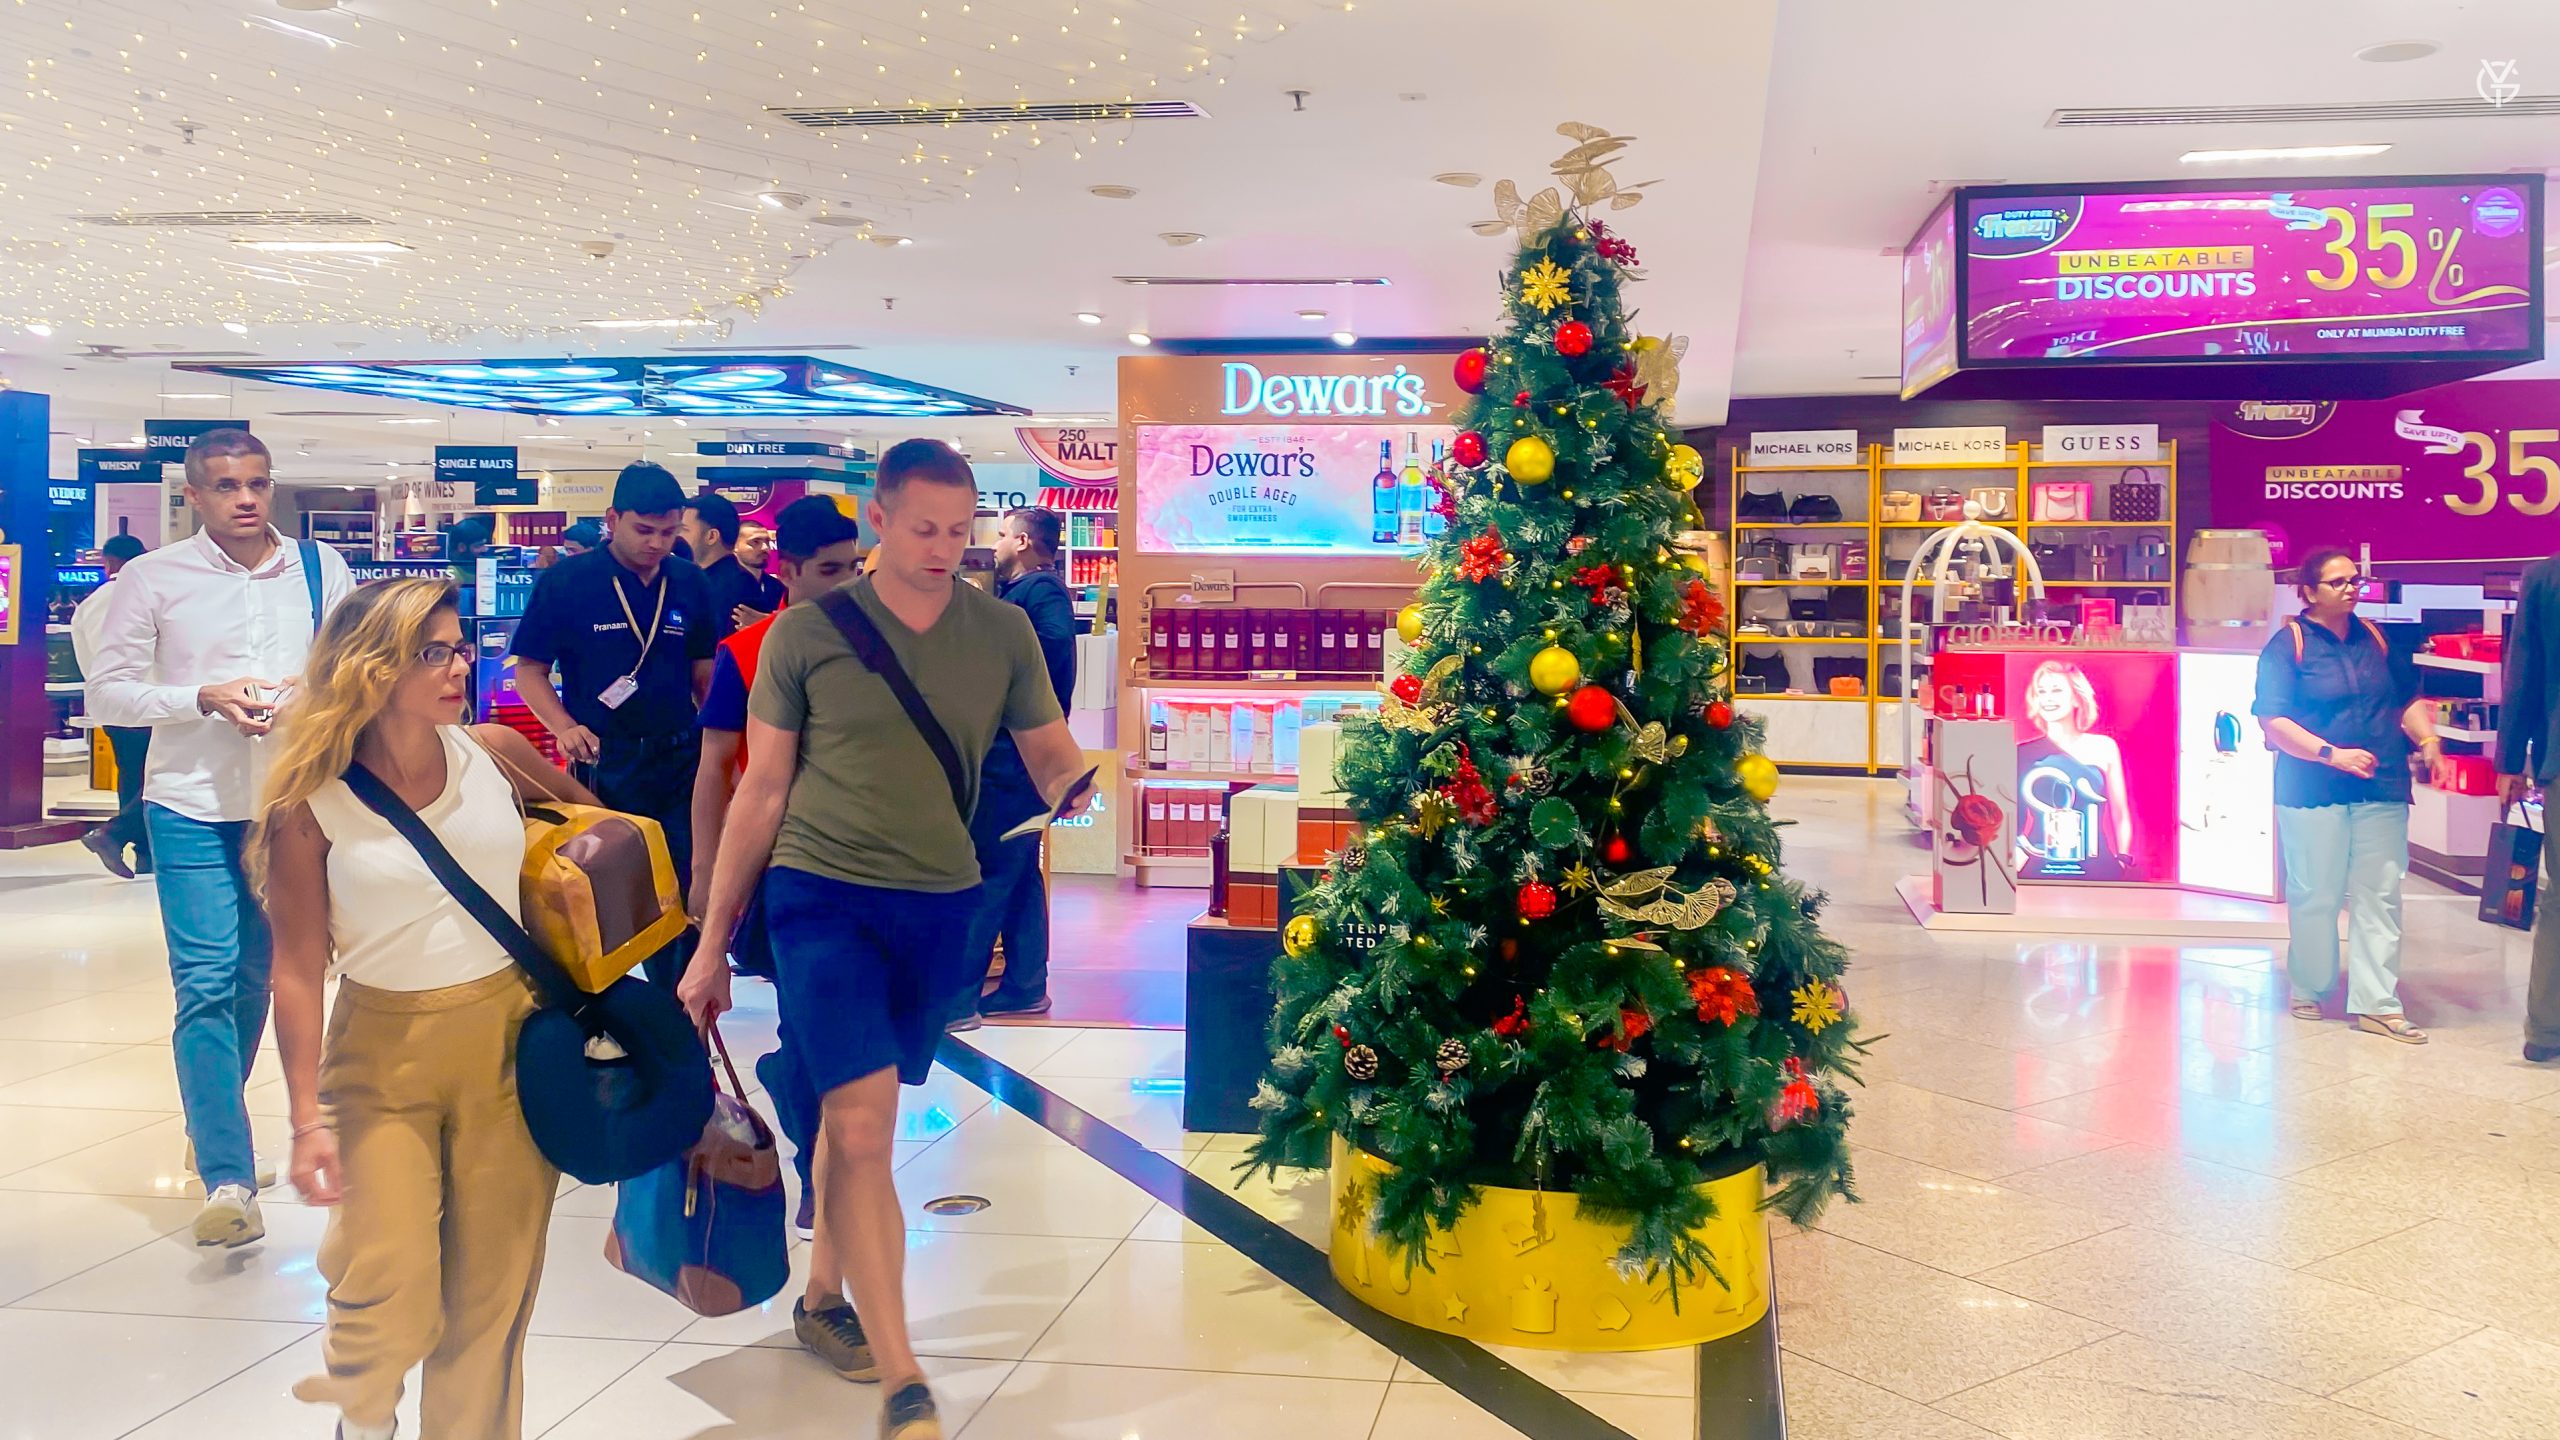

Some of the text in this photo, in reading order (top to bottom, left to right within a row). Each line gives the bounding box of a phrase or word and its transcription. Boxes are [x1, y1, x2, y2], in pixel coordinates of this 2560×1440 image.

[2004, 210, 2053, 219] DUTY FREE
[1980, 213, 2057, 240] Frenzy
[2069, 251, 2244, 268] UNBEATABLE
[2058, 272, 2256, 300] DISCOUNTS
[2316, 326, 2465, 339] ONLY AT MUMBAI DUTY FREE
[2239, 401, 2316, 424] Frenzy
[2402, 426, 2428, 437] SAVE
[727, 443, 786, 454] DUTY FREE
[1754, 442, 1853, 457] MICHAEL KORS
[1898, 438, 2001, 453] MICHAEL KORS
[2061, 435, 2141, 451] GUESS
[98, 461, 141, 471] WHISKY
[438, 458, 514, 470] SINGLE MALTS
[1189, 444, 1316, 477] Dewar's
[2272, 468, 2395, 478] UNBEATABLE
[2443, 429, 2560, 516] 35
[424, 481, 455, 498] WINES
[495, 487, 518, 496] WINE
[1208, 486, 1297, 506] DOUBLE AGED
[2265, 482, 2404, 499] DISCOUNTS
[993, 492, 1026, 509] TO
[58, 571, 99, 583] MALTS
[350, 568, 455, 580] SINGLE MALTS
[593, 621, 628, 633] Pranaam
